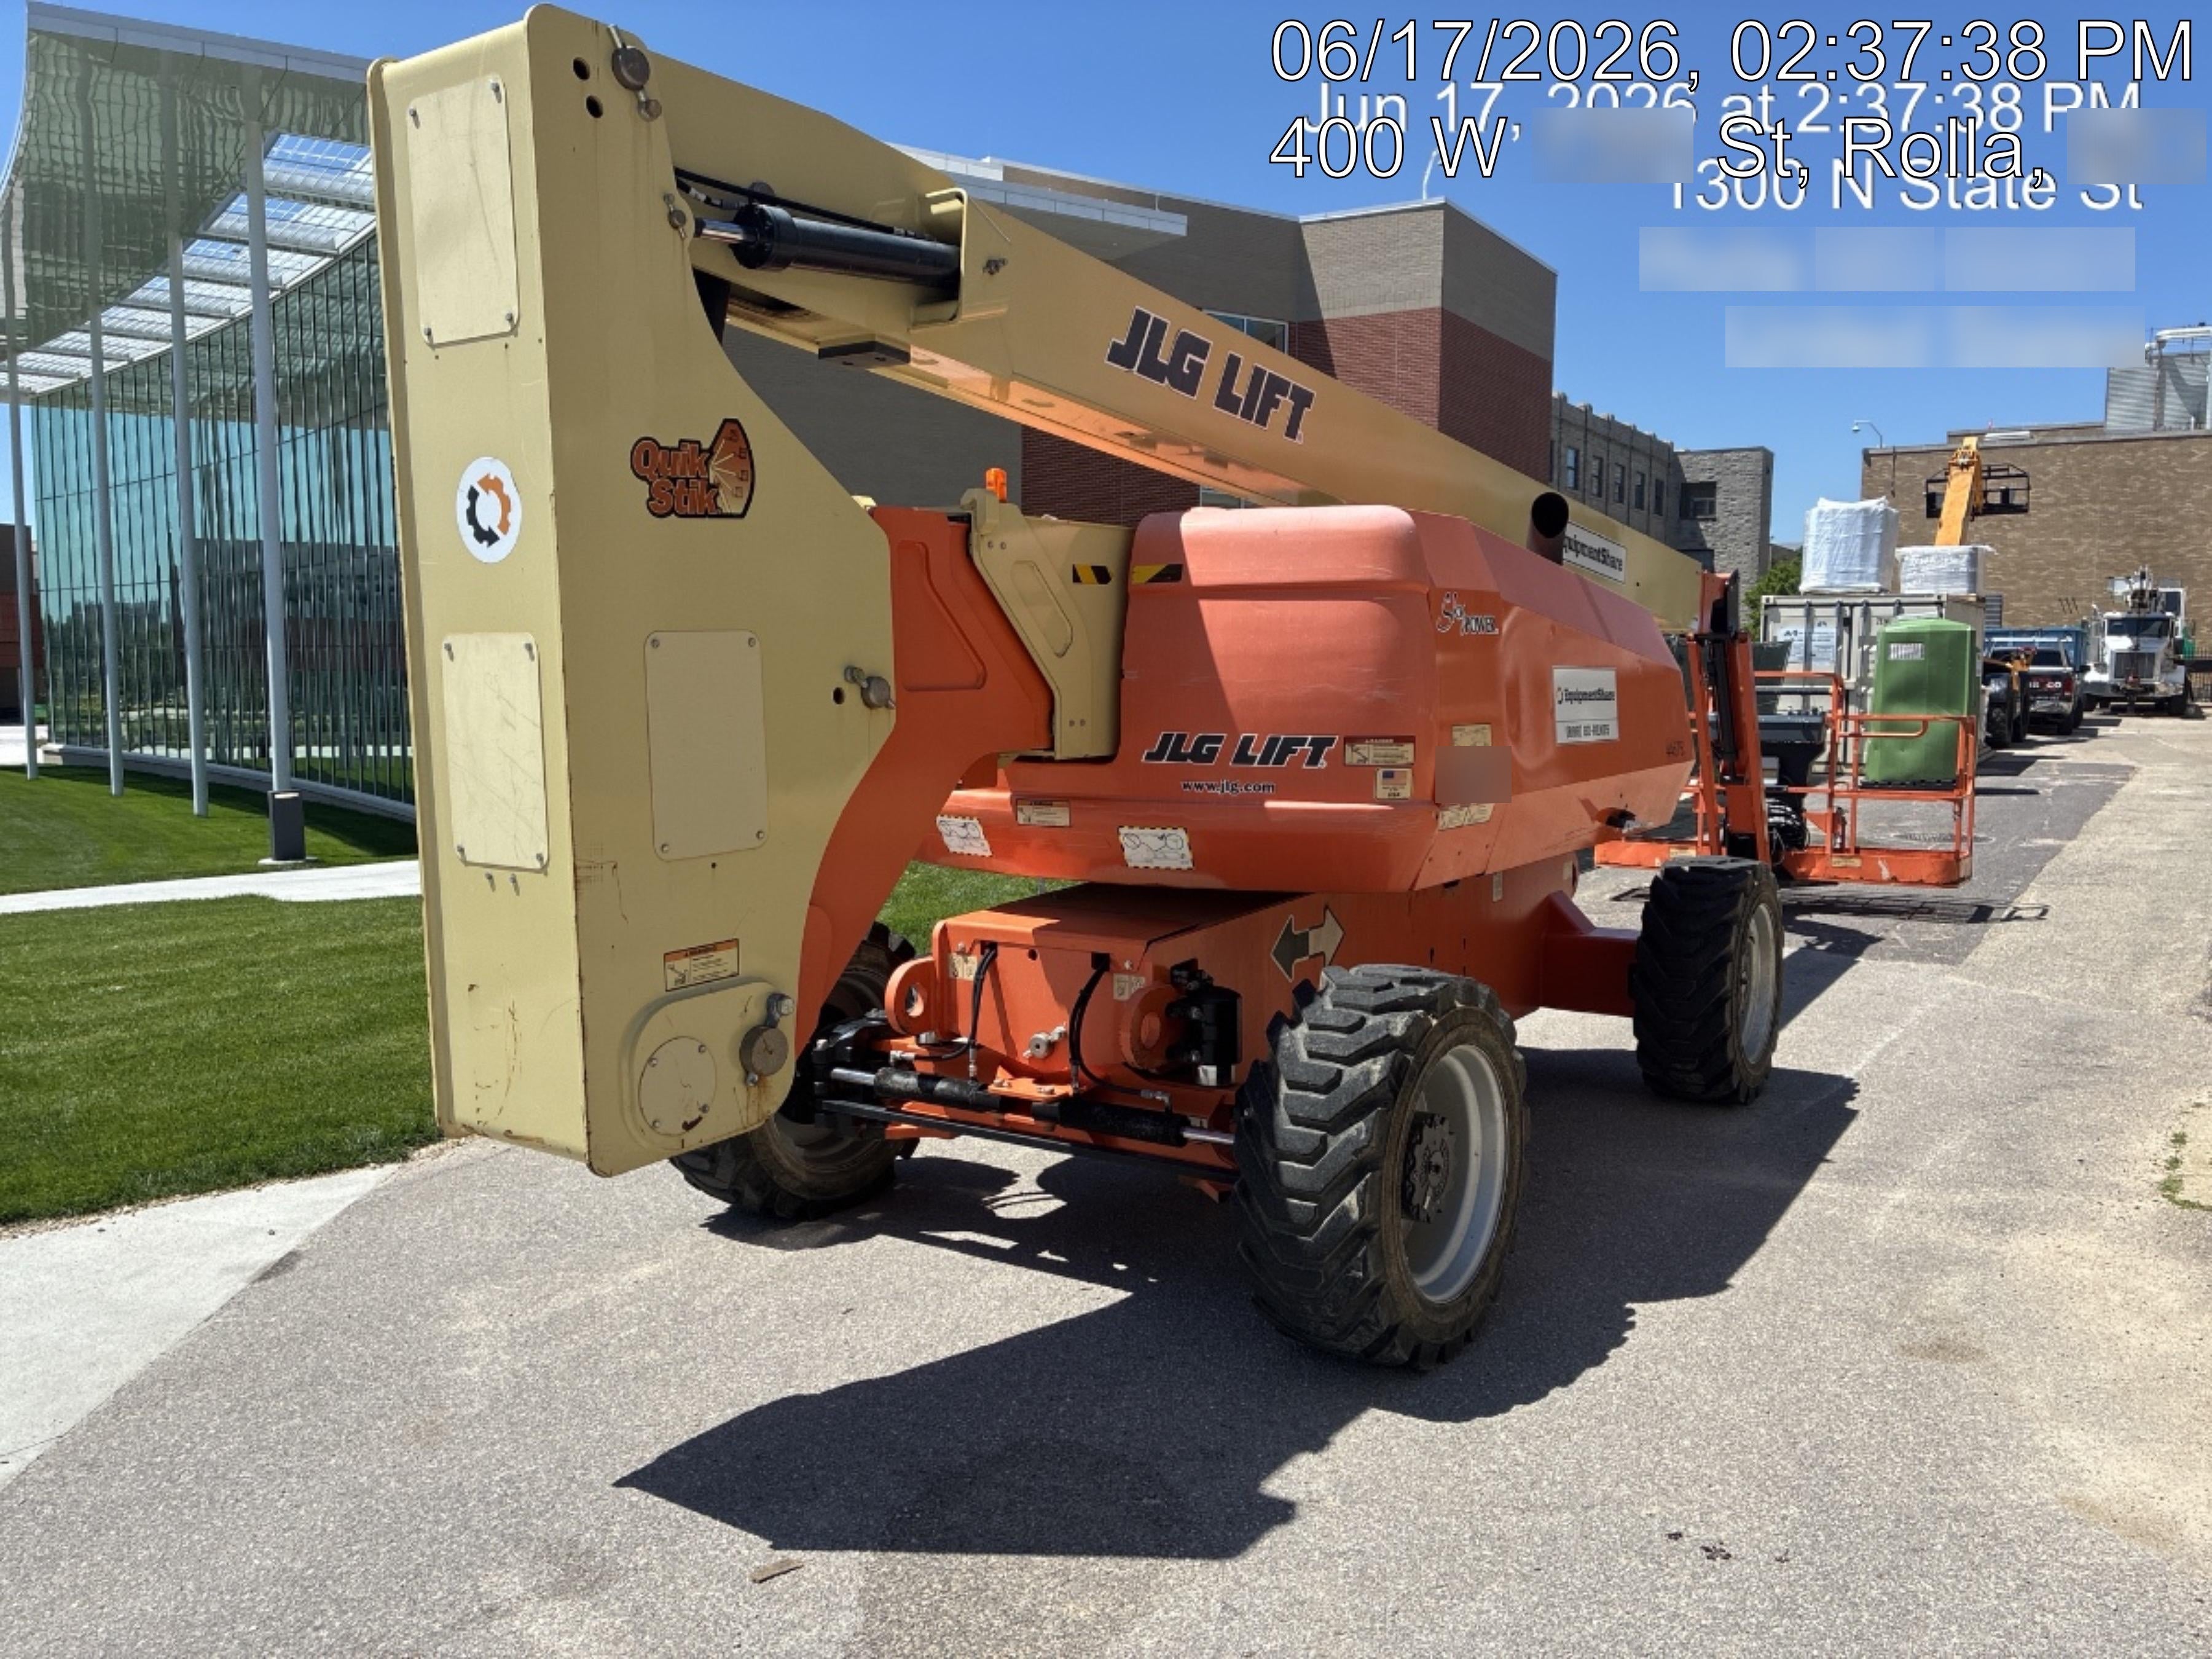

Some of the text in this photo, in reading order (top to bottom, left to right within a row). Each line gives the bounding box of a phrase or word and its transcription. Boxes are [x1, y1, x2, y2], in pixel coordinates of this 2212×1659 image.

[1104, 305, 1317, 444] JLG LIFT
[632, 439, 710, 482] Quik
[648, 478, 719, 515] Stik
[1563, 533, 1623, 572] quipmentShare
[1140, 731, 1228, 766] JLG
[1229, 733, 1339, 769] LIFT
[1180, 780, 1276, 794] www.jlg.com
